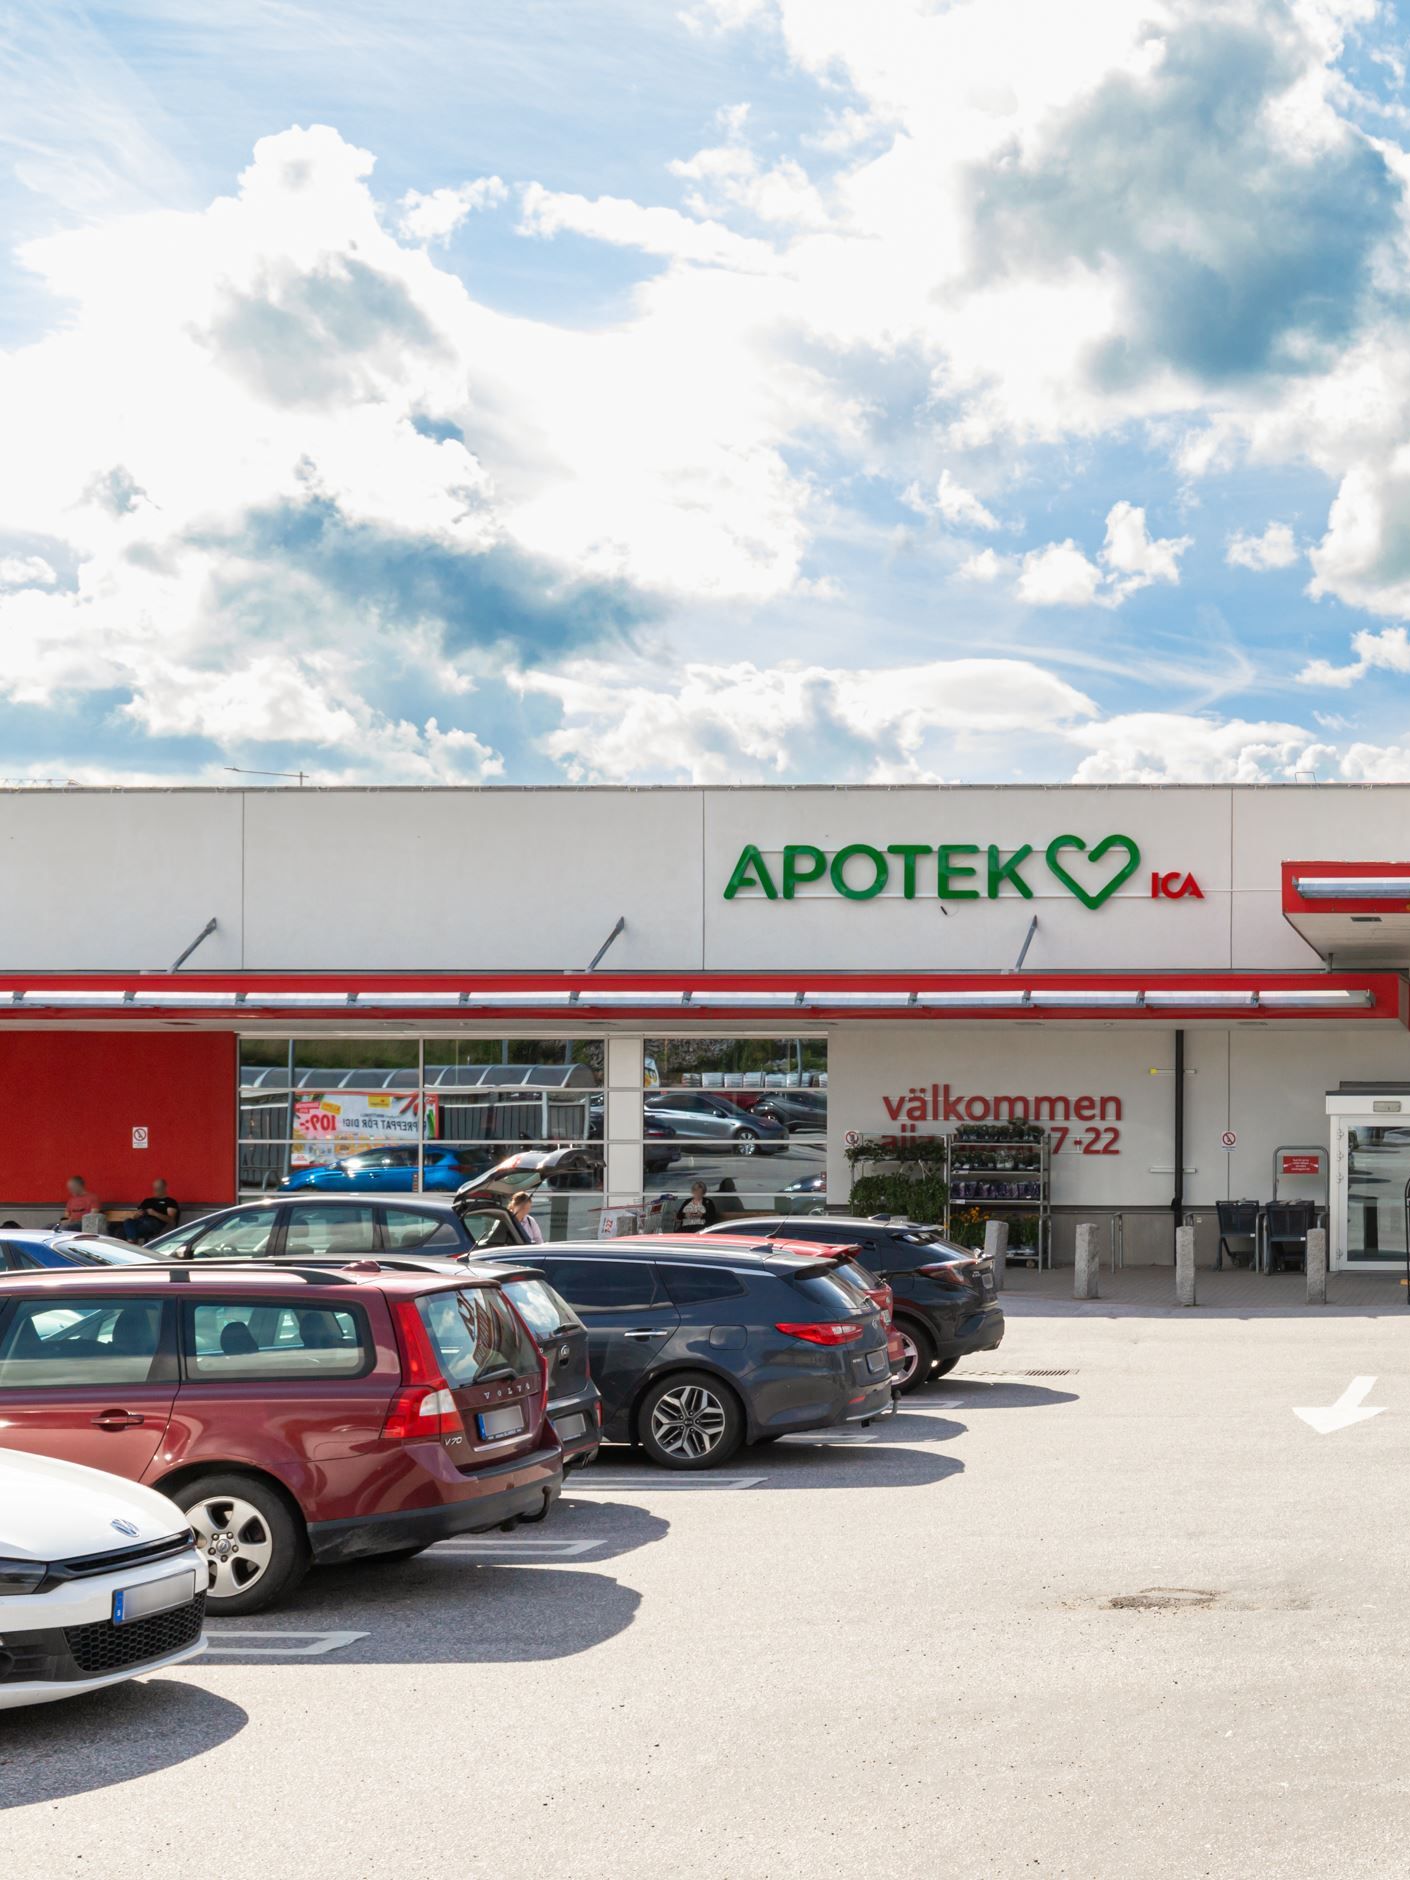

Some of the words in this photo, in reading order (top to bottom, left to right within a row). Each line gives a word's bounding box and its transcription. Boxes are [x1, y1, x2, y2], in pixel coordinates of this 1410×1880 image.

[723, 843, 1034, 901] APOTEK
[1151, 871, 1205, 899] ICA
[882, 1084, 1122, 1121] välkommen
[1050, 1127, 1120, 1155] 7-22
[444, 1436, 463, 1446] V70
